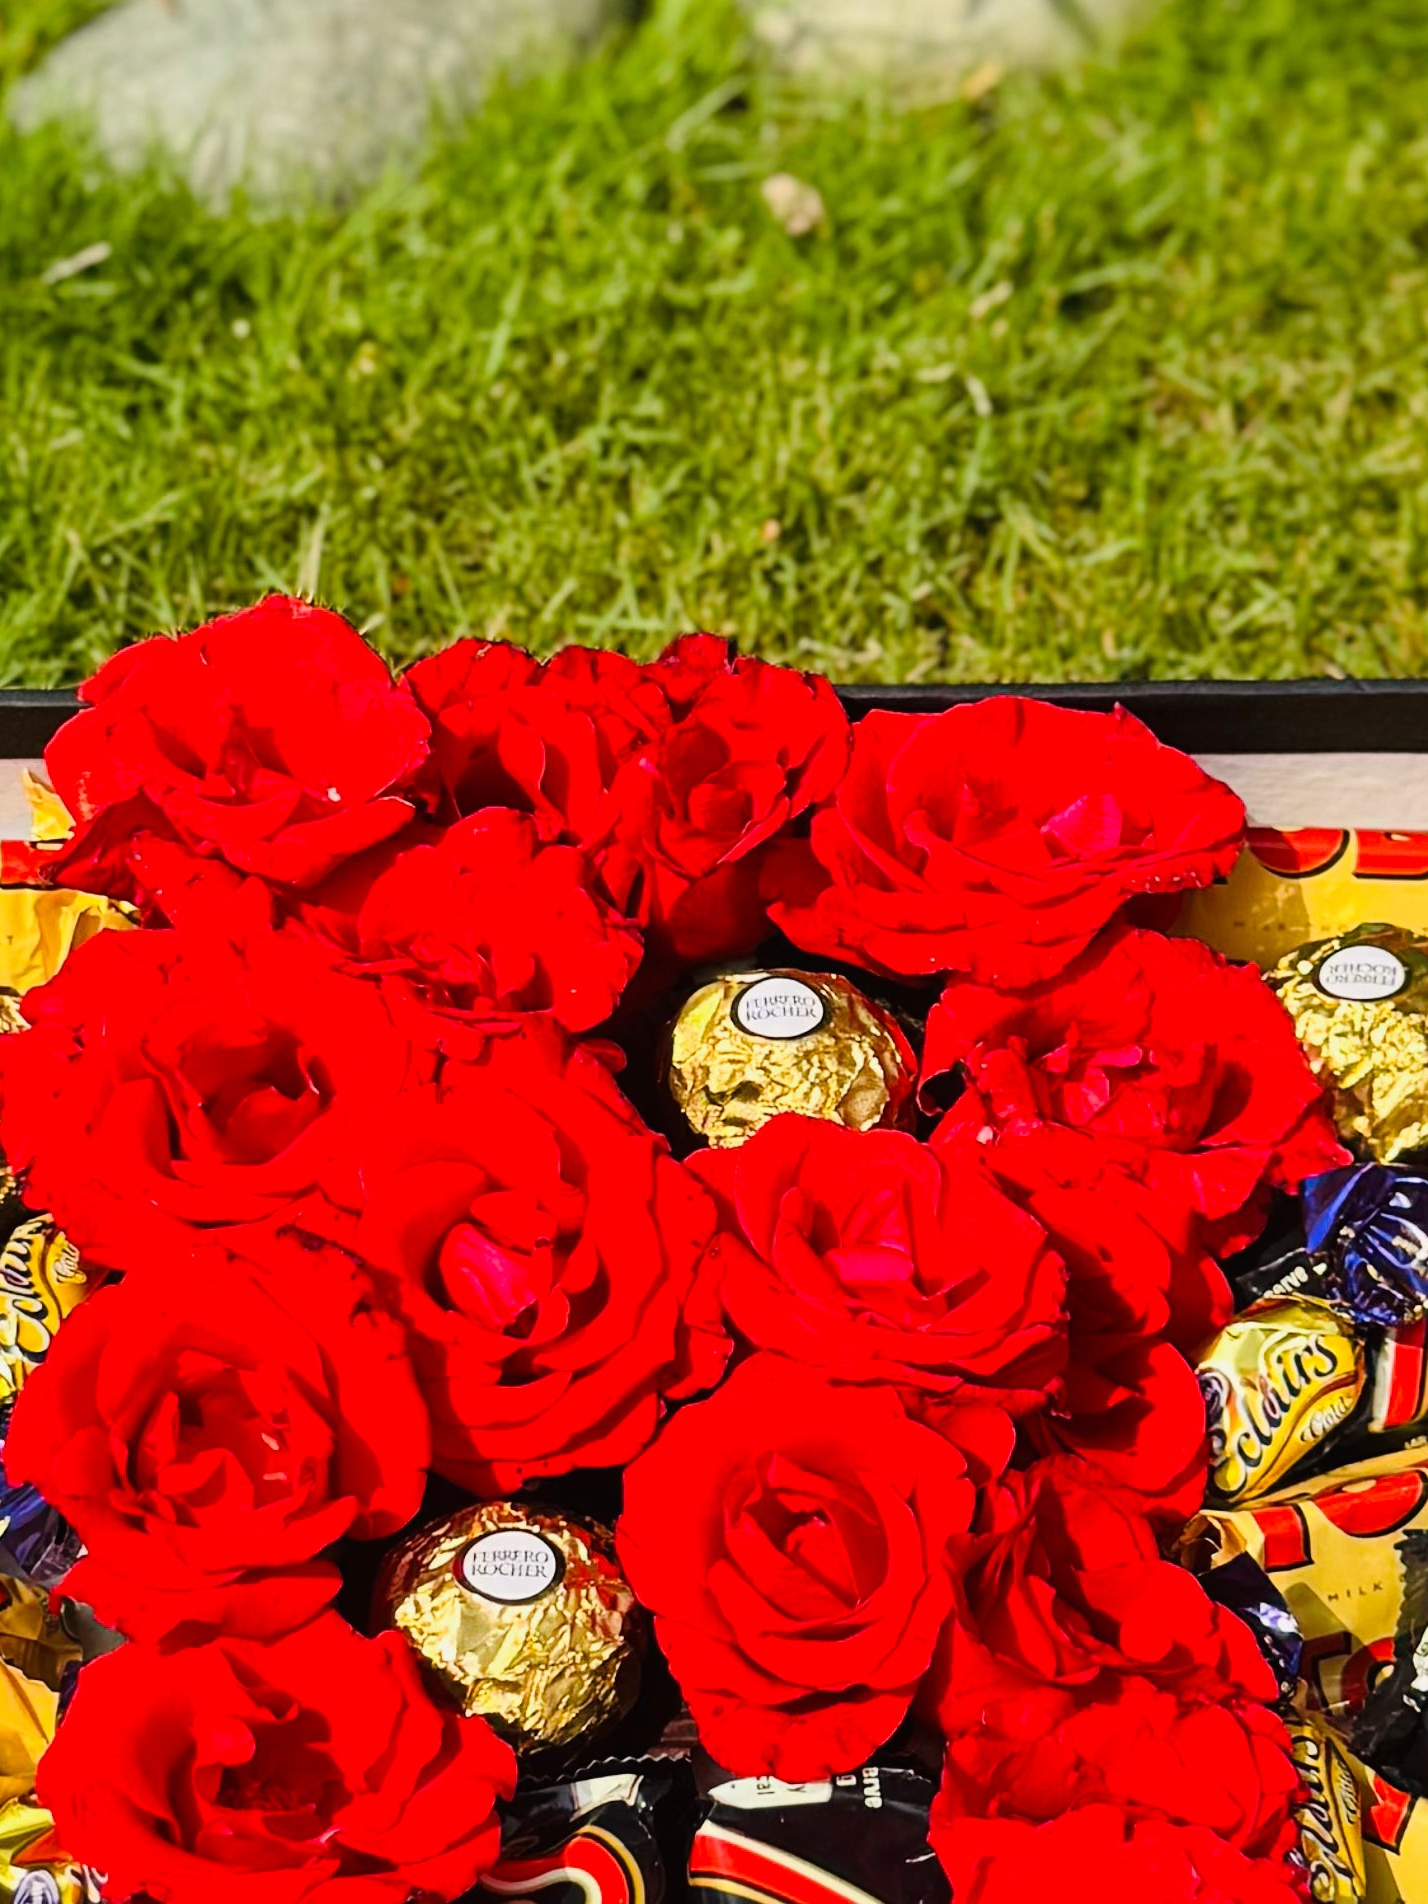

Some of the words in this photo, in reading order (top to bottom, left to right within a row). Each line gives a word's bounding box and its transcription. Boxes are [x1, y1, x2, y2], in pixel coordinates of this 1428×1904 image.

[744, 994, 816, 1009] FERRERO
[745, 1004, 818, 1021] ROCHER
[472, 1549, 549, 1564] FERRERO
[471, 1562, 549, 1579] ROCHER
[1327, 1581, 1384, 1602] MILK
